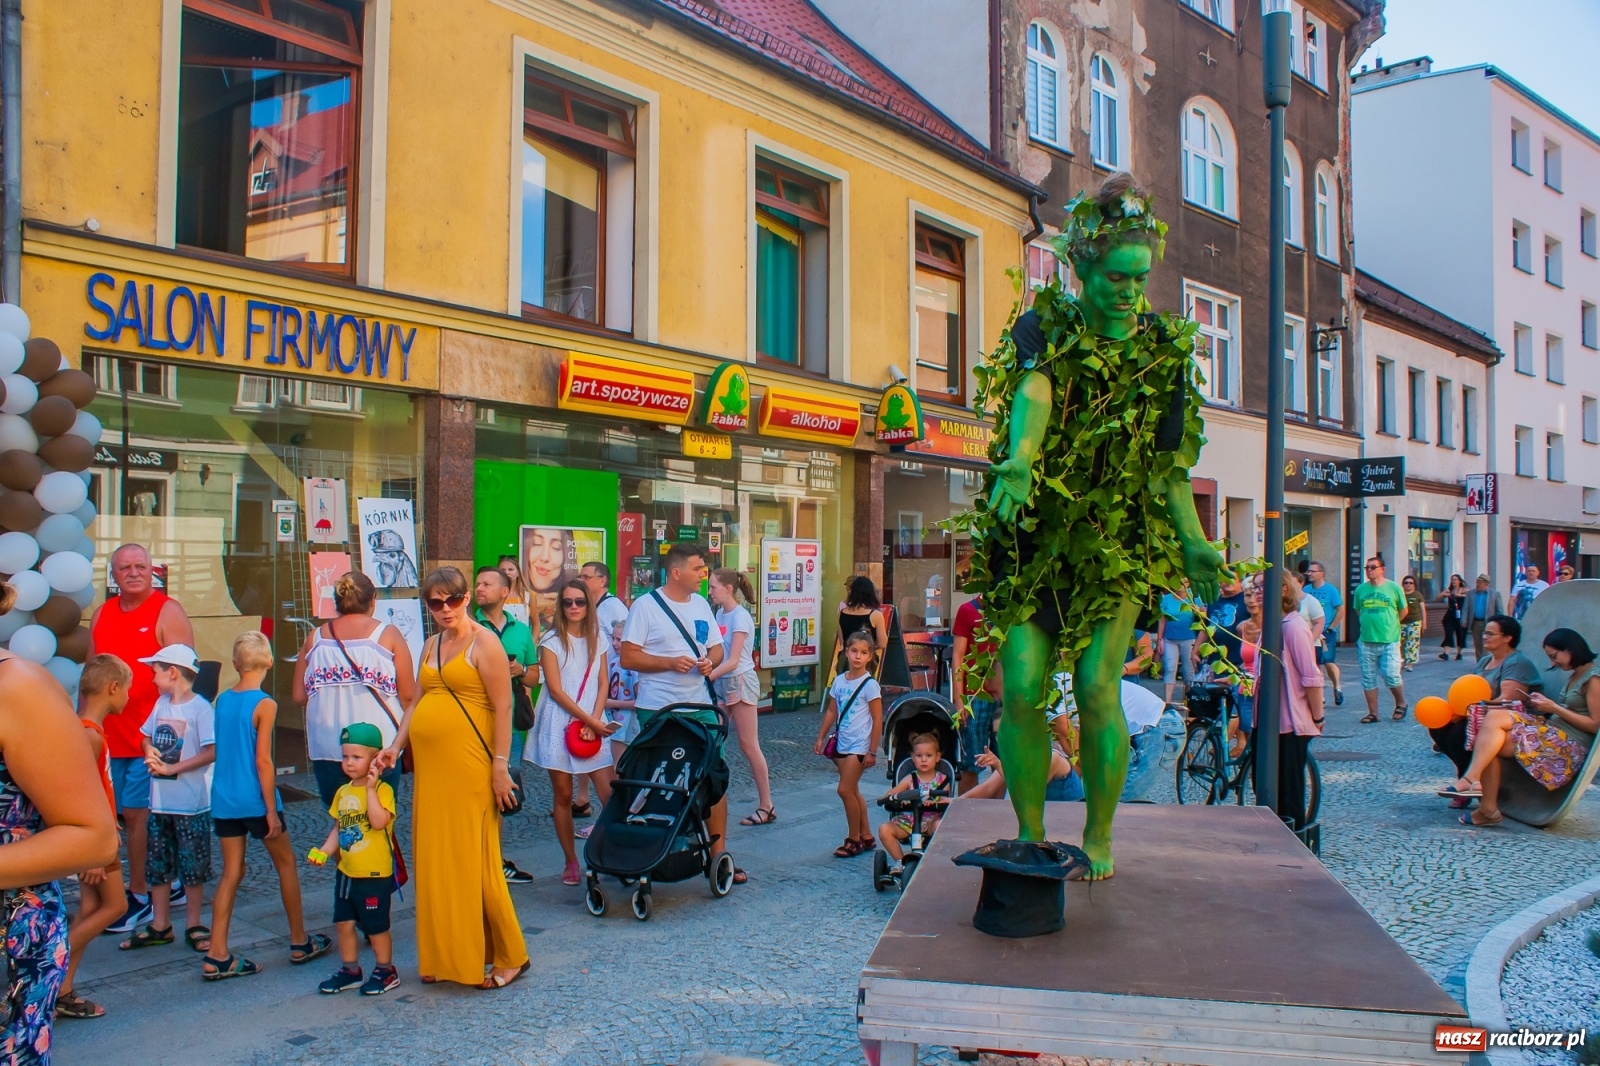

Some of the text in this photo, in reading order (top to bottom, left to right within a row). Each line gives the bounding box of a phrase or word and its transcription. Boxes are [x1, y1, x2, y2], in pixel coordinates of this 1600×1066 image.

[84, 272, 417, 381] SALON FIRMOWY
[571, 379, 689, 410] art.spożywcze
[712, 412, 748, 427] żabka
[791, 412, 842, 431] alkohol
[877, 429, 914, 440] żabka
[939, 419, 984, 439] MARMARA
[689, 433, 730, 446] OTWARTE
[699, 446, 705, 455] 6
[711, 446, 717, 455] 2
[1302, 458, 1352, 489] Jubiler Złotnik
[1361, 464, 1395, 479] Jubiler
[1361, 479, 1396, 492] Złotnik
[567, 550, 599, 562] drugie
